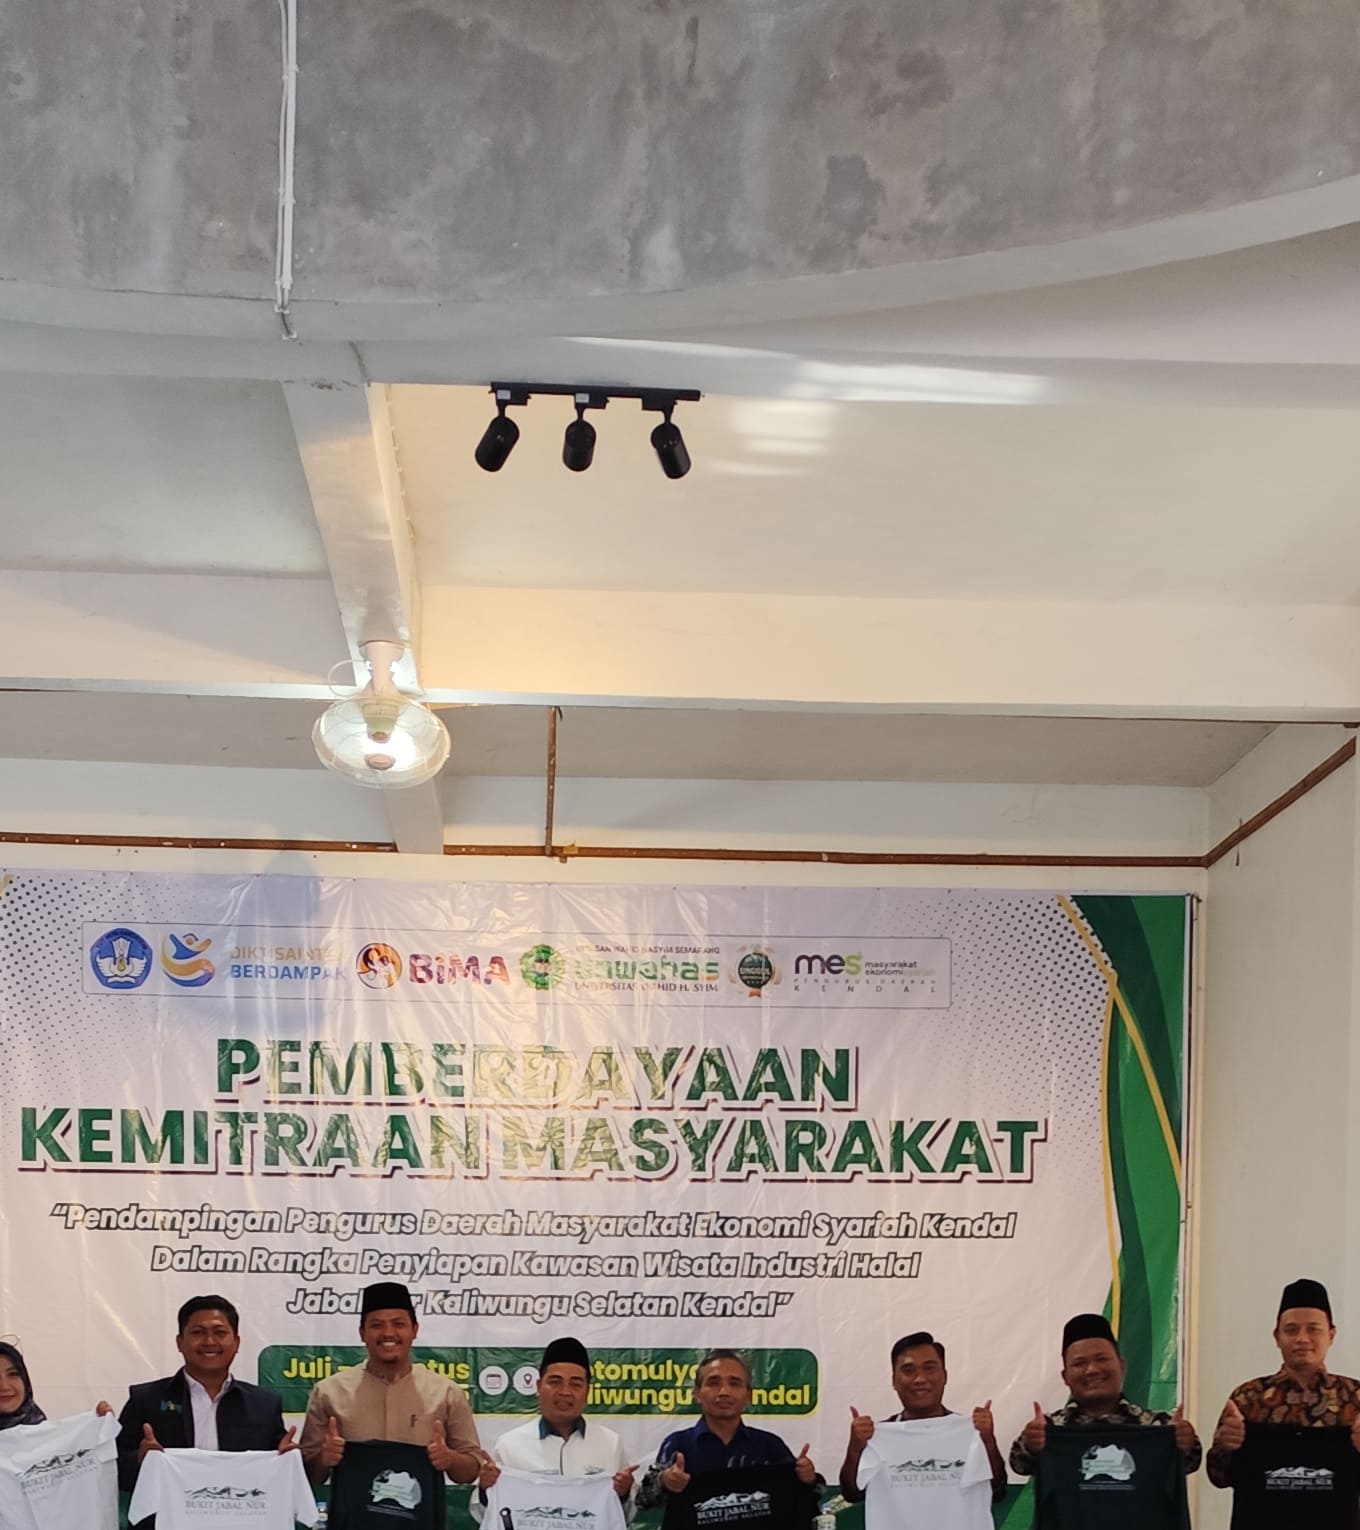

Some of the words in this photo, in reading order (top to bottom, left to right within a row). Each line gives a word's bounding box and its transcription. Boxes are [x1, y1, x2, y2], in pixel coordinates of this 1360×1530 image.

[794, 952, 863, 976] mes
[217, 1037, 852, 1102] PEMBERDAYAAN
[20, 1106, 480, 1168] KEMITRAAN
[502, 1116, 1039, 1175] MASYARAKAT
[285, 1207, 417, 1241] Pengurus
[419, 1209, 522, 1235] Daerah
[524, 1210, 691, 1244] Masyarakat
[692, 1210, 812, 1238] Ekonomi
[813, 1210, 917, 1246] Syariah
[919, 1212, 1018, 1238] Kendal
[151, 1245, 247, 1273] Dalam
[248, 1247, 359, 1281] Rangka
[360, 1247, 508, 1283] Penyiapan
[511, 1250, 639, 1277] Kawasan
[643, 1249, 740, 1278] Wisata
[740, 1250, 848, 1278] Industri
[848, 1252, 922, 1278] Halal
[423, 1288, 571, 1324] Kaliwungu
[573, 1290, 678, 1316] Selatan
[283, 1356, 331, 1379] Juli
